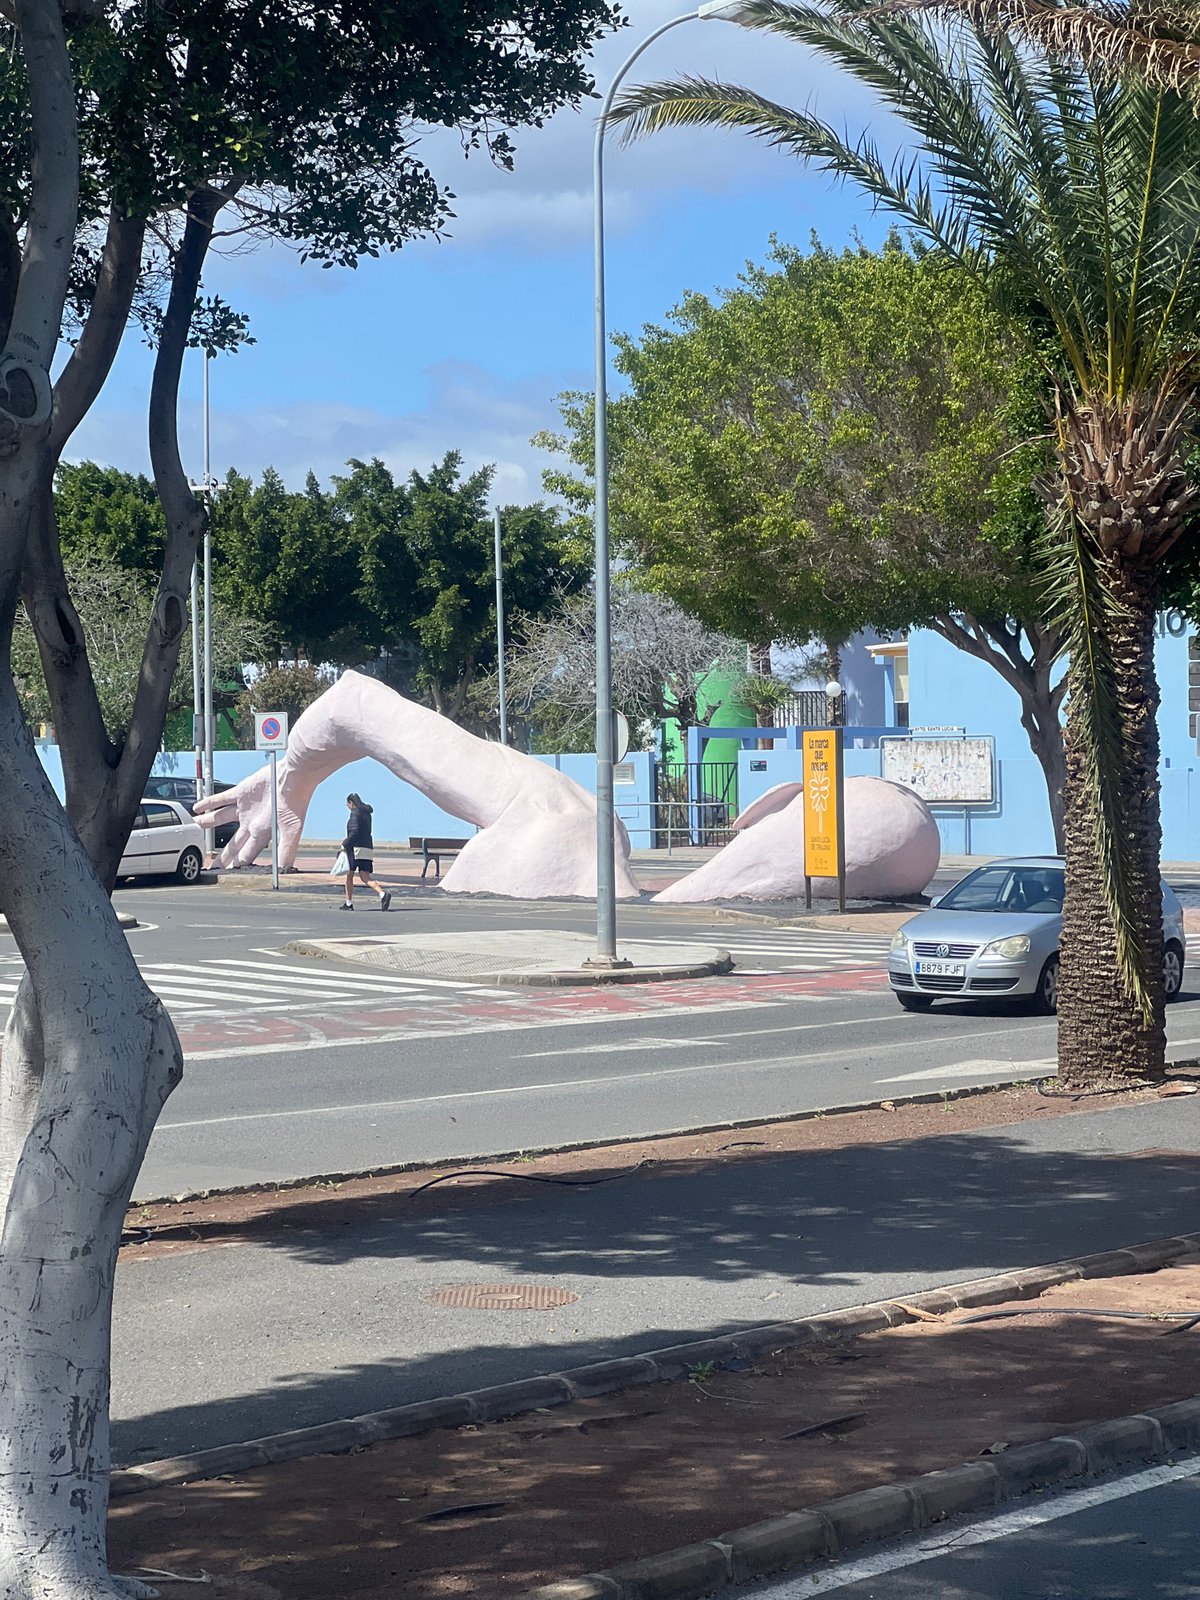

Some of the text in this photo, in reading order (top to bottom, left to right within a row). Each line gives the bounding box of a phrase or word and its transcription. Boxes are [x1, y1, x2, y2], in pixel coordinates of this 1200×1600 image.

[808, 738, 829, 749] La marca
[814, 750, 823, 761] que
[811, 761, 819, 771] nos
[921, 963, 961, 975] 8879 FJF
